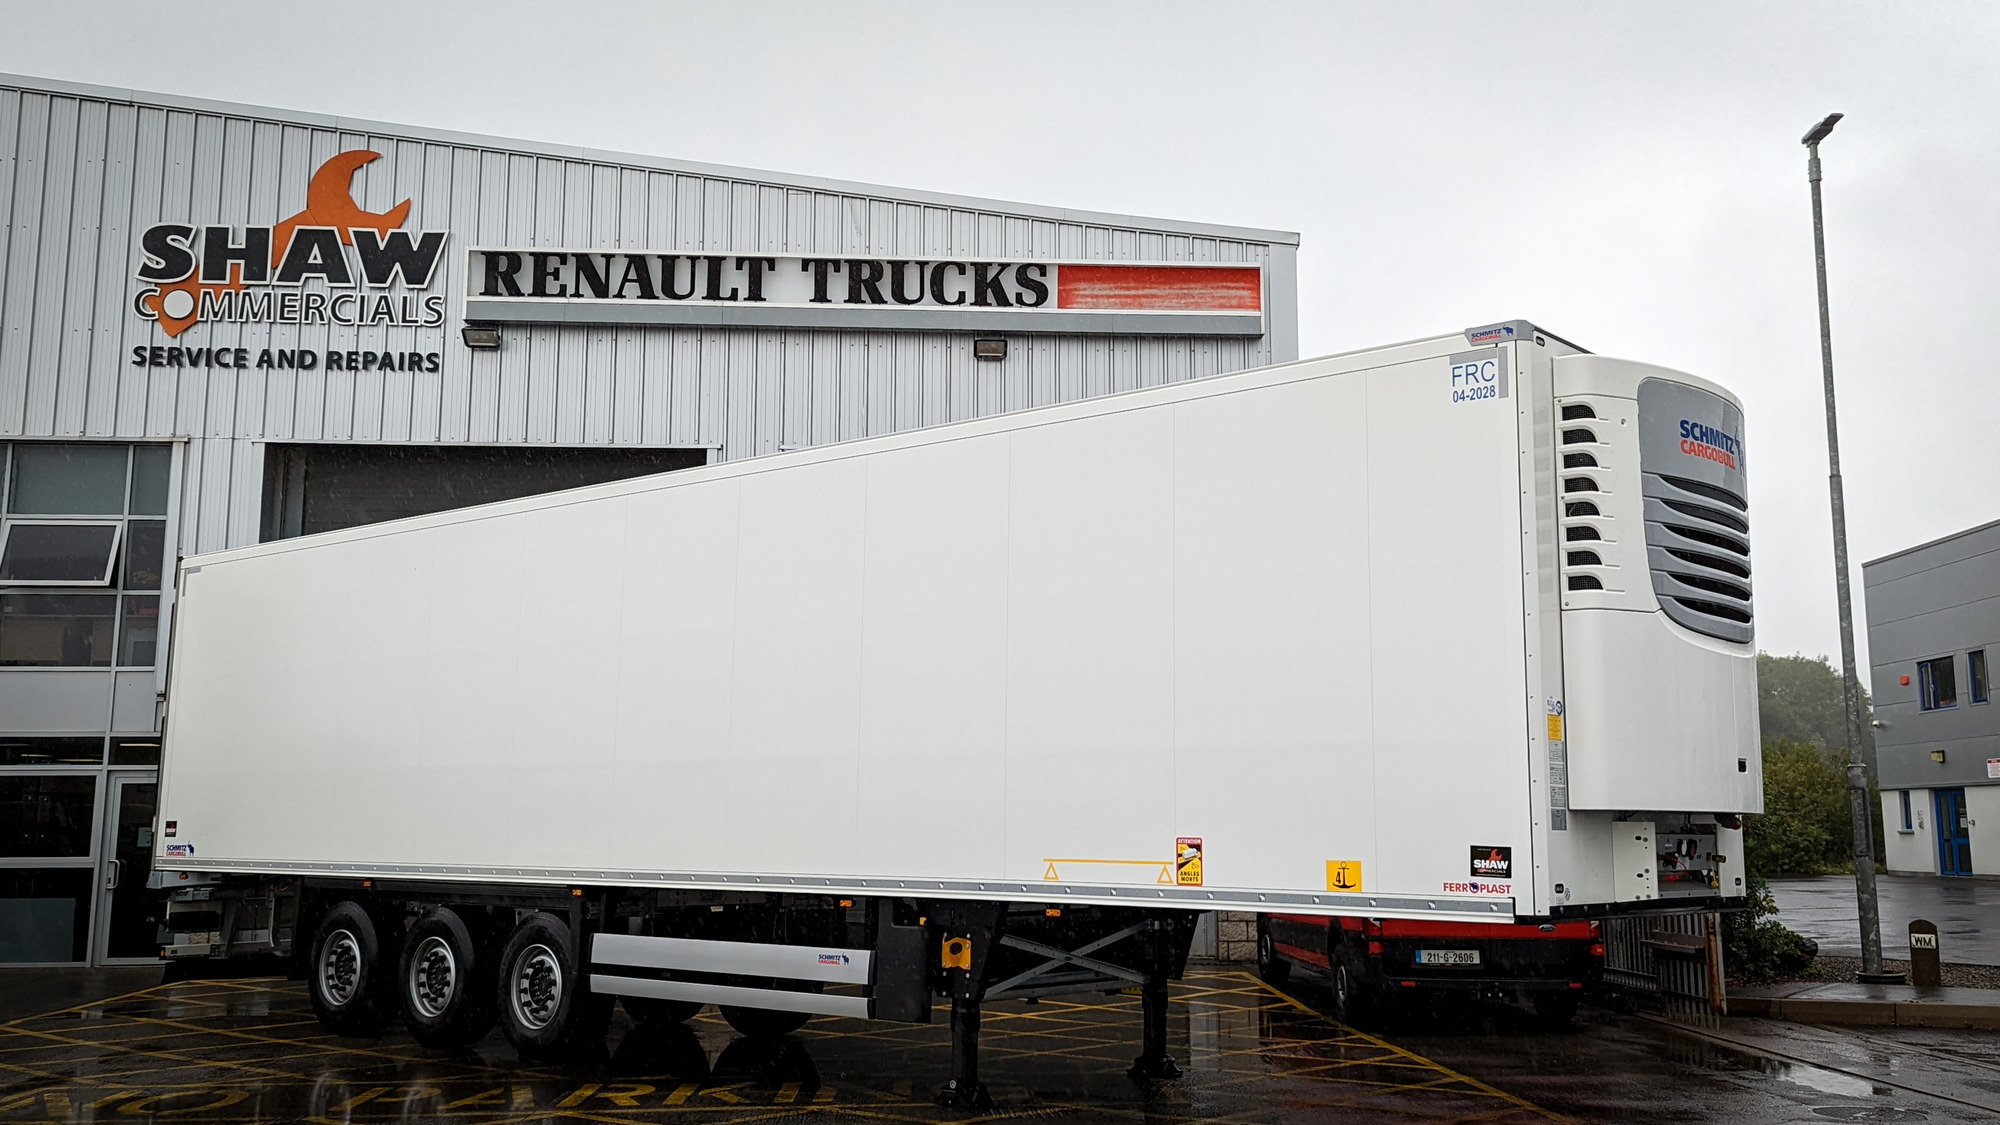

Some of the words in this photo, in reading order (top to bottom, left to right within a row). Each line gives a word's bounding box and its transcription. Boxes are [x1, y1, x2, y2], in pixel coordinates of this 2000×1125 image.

[134, 223, 449, 288] SHAW
[479, 251, 775, 301] RENAULT
[801, 258, 1049, 308] TRUCKS
[133, 288, 446, 327] COMMERCIALS
[1471, 328, 1502, 338] SCHMITZ
[132, 345, 248, 370] SERVICE
[256, 349, 318, 371] AND
[326, 351, 440, 373] REPAIRS
[1452, 361, 1496, 387] FRC
[1453, 385, 1496, 403] 04-2028
[1680, 419, 1735, 456] SCHMITZ
[1680, 439, 1736, 470] CARGOBULL
[1473, 859, 1509, 870] SHAW
[1443, 881, 1511, 894] FERROPLAST
[818, 953, 841, 961] SCHMITZ
[1427, 952, 1475, 963] 211-G-2606
